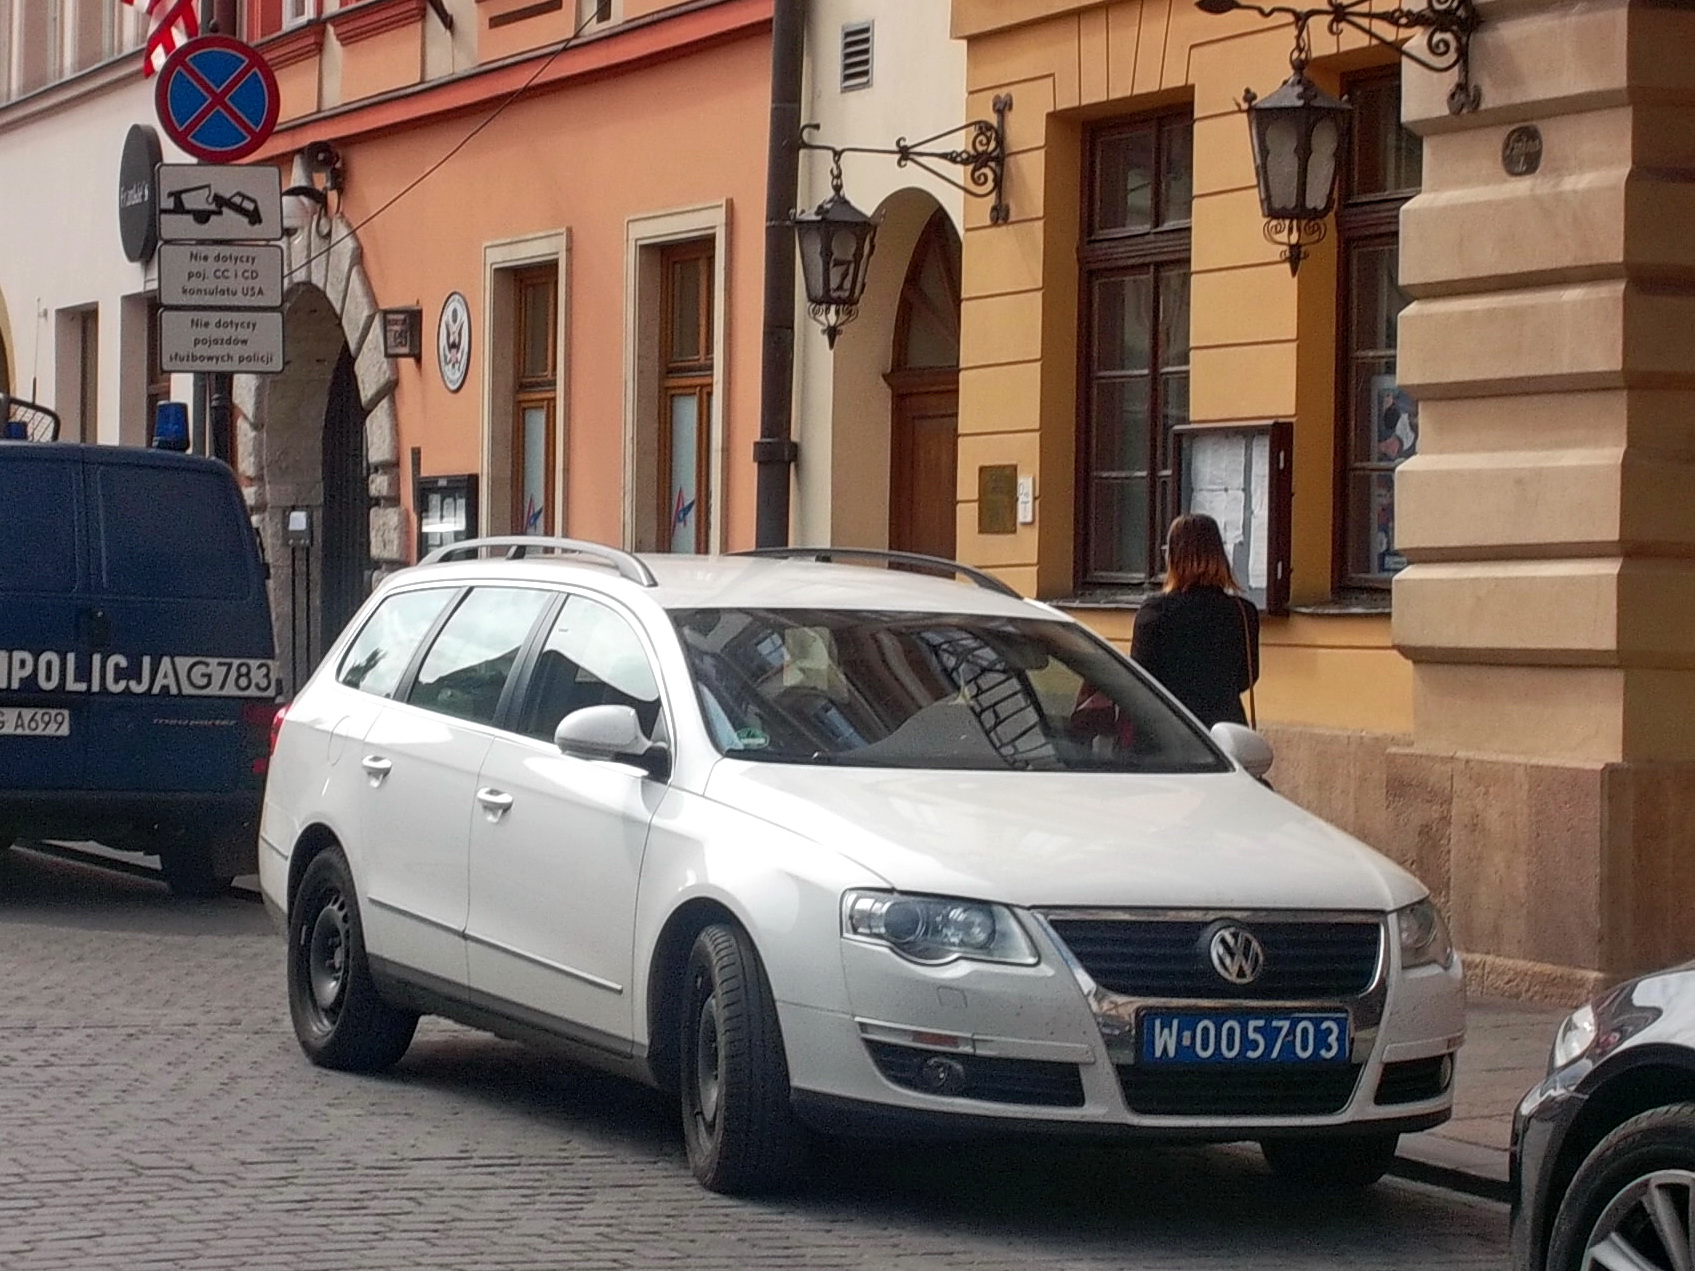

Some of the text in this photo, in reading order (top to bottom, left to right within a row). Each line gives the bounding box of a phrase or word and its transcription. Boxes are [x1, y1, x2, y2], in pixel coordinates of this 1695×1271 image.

[190, 252, 256, 265] Nie dotyczy
[213, 269, 229, 279] CC
[241, 270, 259, 280] CD
[181, 286, 264, 297] konsulatu USA
[190, 318, 257, 331] Nie dotyczy
[193, 336, 249, 347] pojazdów
[169, 352, 273, 365] służbowych policji
[11, 651, 272, 695] POLICJA G783
[14, 710, 65, 733] A699
[1195, 1019, 1339, 1060] 005703
